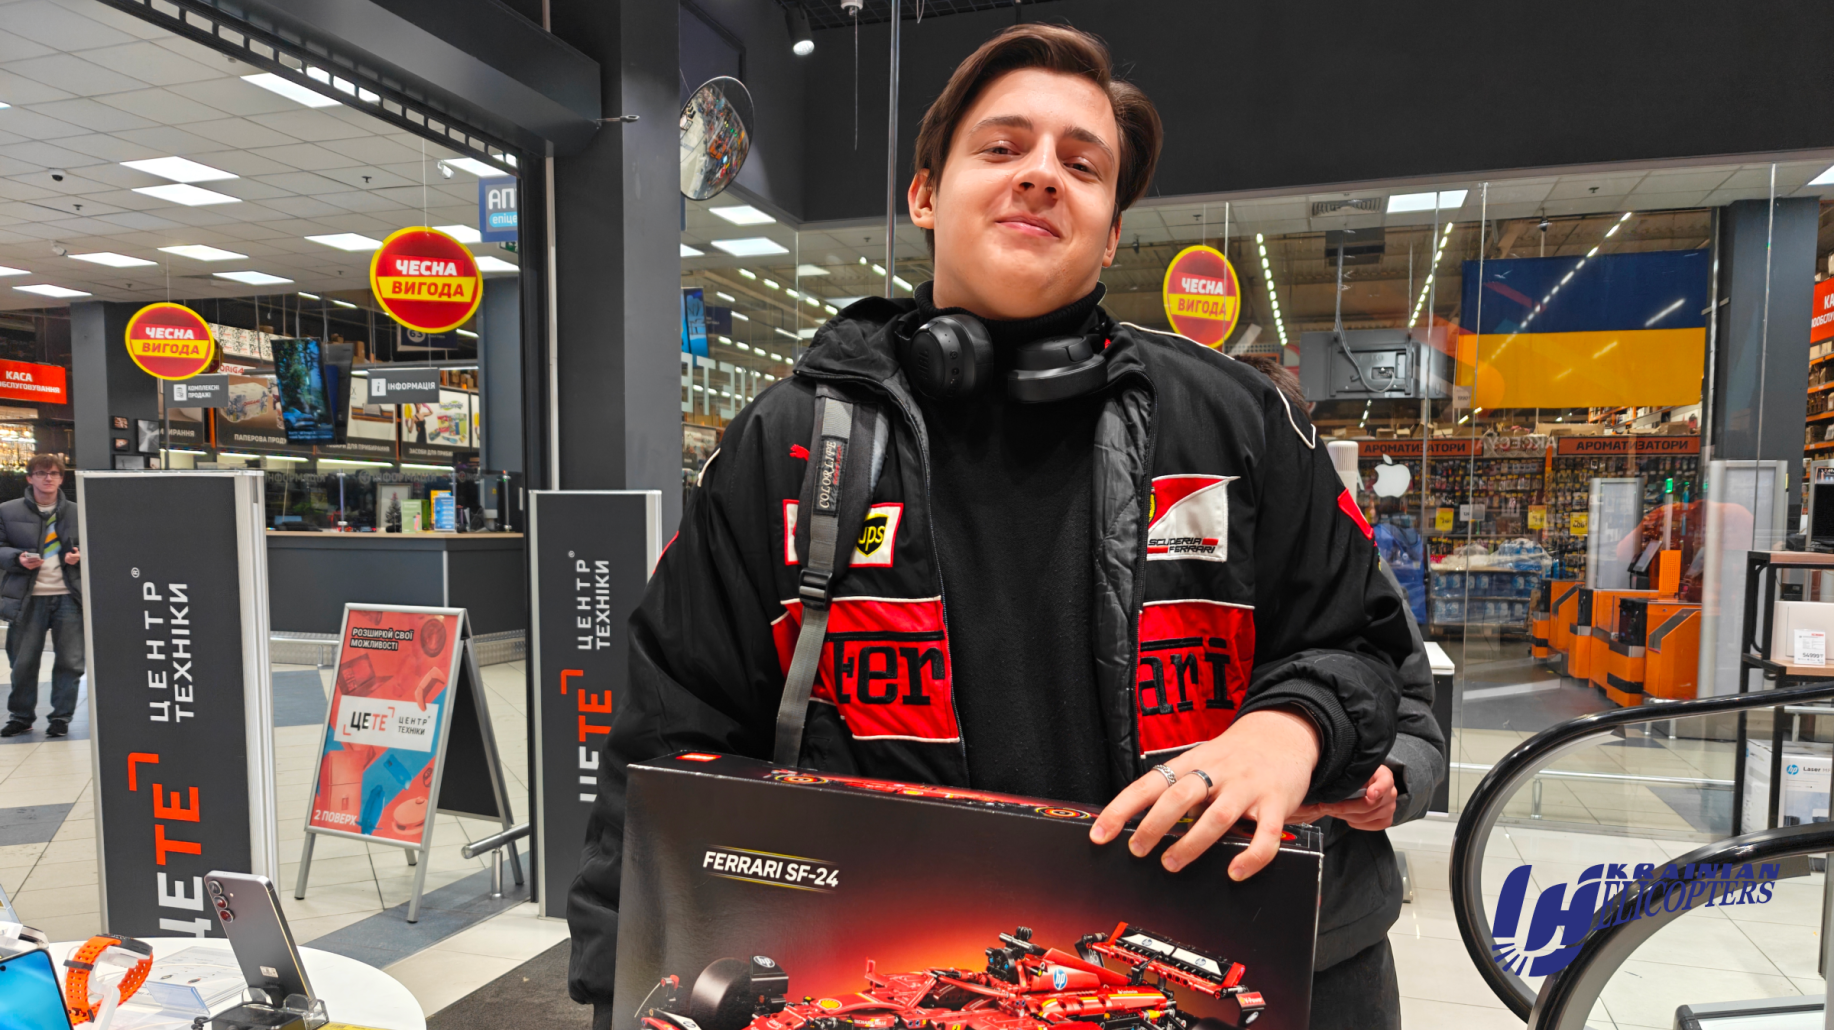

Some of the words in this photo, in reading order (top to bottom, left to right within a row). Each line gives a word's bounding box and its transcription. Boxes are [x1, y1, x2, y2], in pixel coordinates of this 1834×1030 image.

[488, 188, 517, 210] АП
[396, 259, 457, 276] ЧЕСНА
[391, 280, 464, 299] ВИГОДА
[1181, 277, 1224, 295] ЧЕСНА
[1177, 297, 1227, 316] ВИГОДА
[145, 326, 195, 340] ЧЕСНА
[141, 342, 200, 356] ВИГОДА
[5, 370, 34, 383] КАСА
[387, 381, 436, 391] ІНФОРМАЦІЯ
[233, 433, 267, 444] ПАПЕРОВА
[1576, 440, 1688, 451] АРОМАТИЗАТОРИ
[1148, 537, 1203, 546] SCUDERIA
[1168, 545, 1217, 554] FERRARI
[576, 559, 594, 650] ЦЕНТР
[595, 560, 611, 651] ТЕХНІКИ
[352, 627, 394, 639] РОЗШИРЮЙ
[395, 629, 414, 641] СВОЇ
[143, 581, 169, 722] ЦЕНТР
[169, 582, 195, 723] ТЕХНІКИ
[350, 638, 398, 650] МОЖЛИВОСТІ
[351, 711, 388, 732] ЦЕТЕ
[398, 715, 428, 725] ЦЕНТР
[398, 726, 425, 735] ТЕХНІКИ
[314, 809, 320, 820] 2
[321, 811, 357, 826] ПОВЕРХ
[702, 851, 783, 879] FERRARI
[785, 862, 839, 888] SF-24
[1054, 969, 1066, 990] hp
